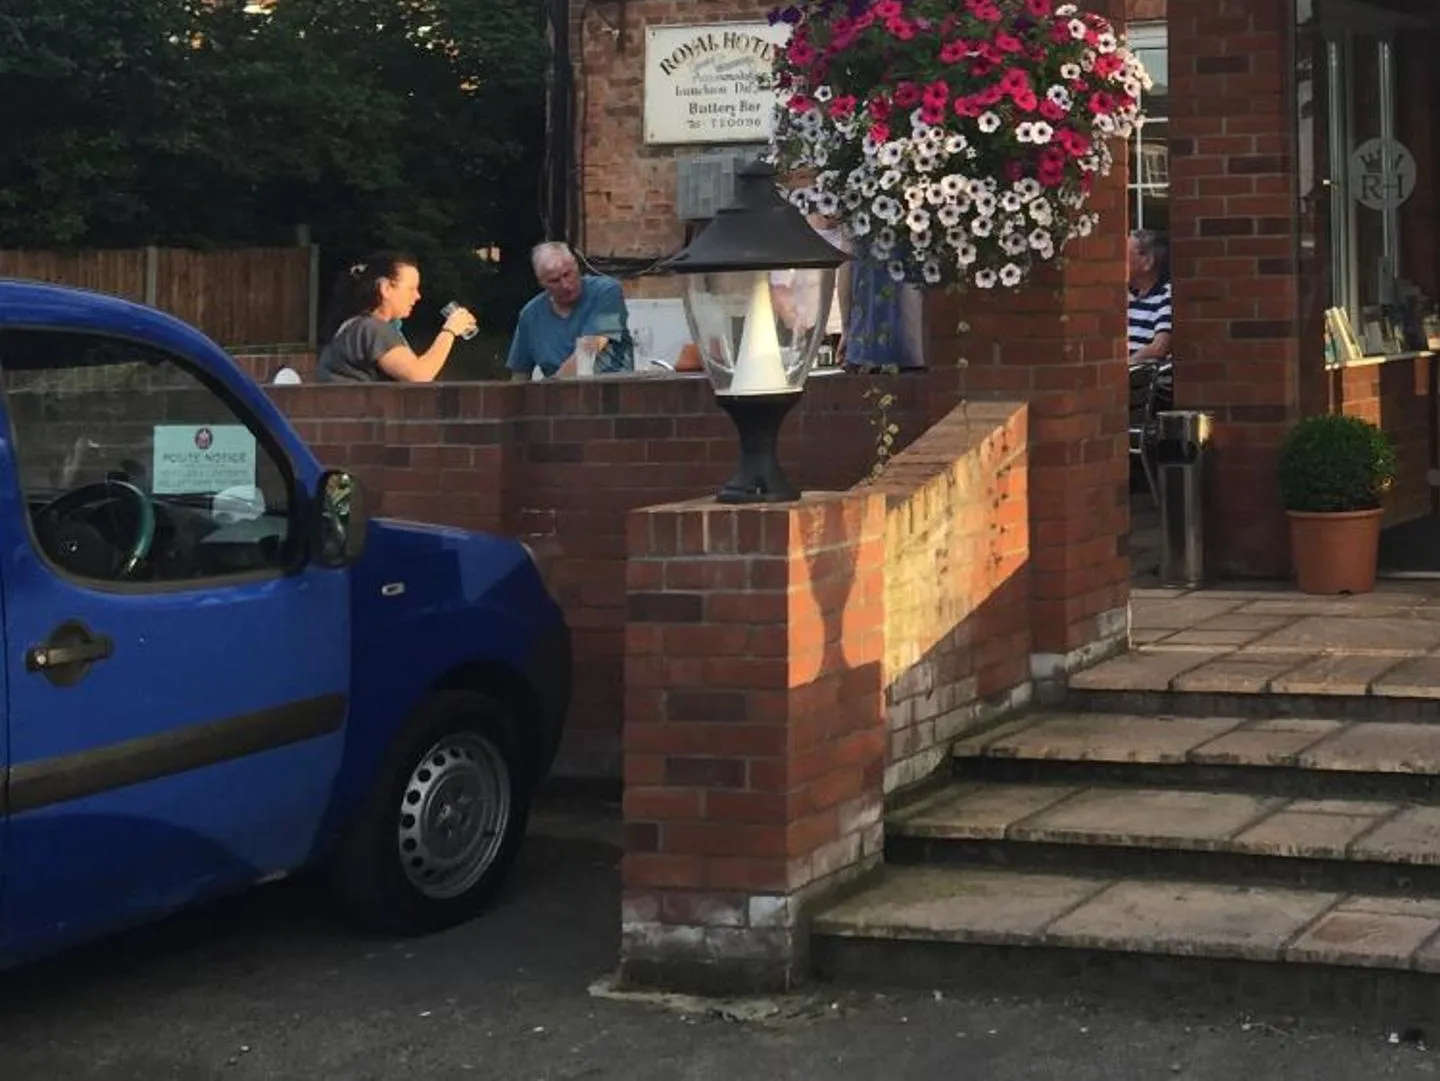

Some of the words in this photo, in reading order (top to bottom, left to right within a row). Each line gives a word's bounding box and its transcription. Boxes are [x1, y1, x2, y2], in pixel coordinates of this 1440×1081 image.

[659, 33, 718, 76] ROYAL
[723, 31, 772, 63] HOTE
[740, 100, 761, 113] Bar
[205, 451, 247, 463] NOTICE
